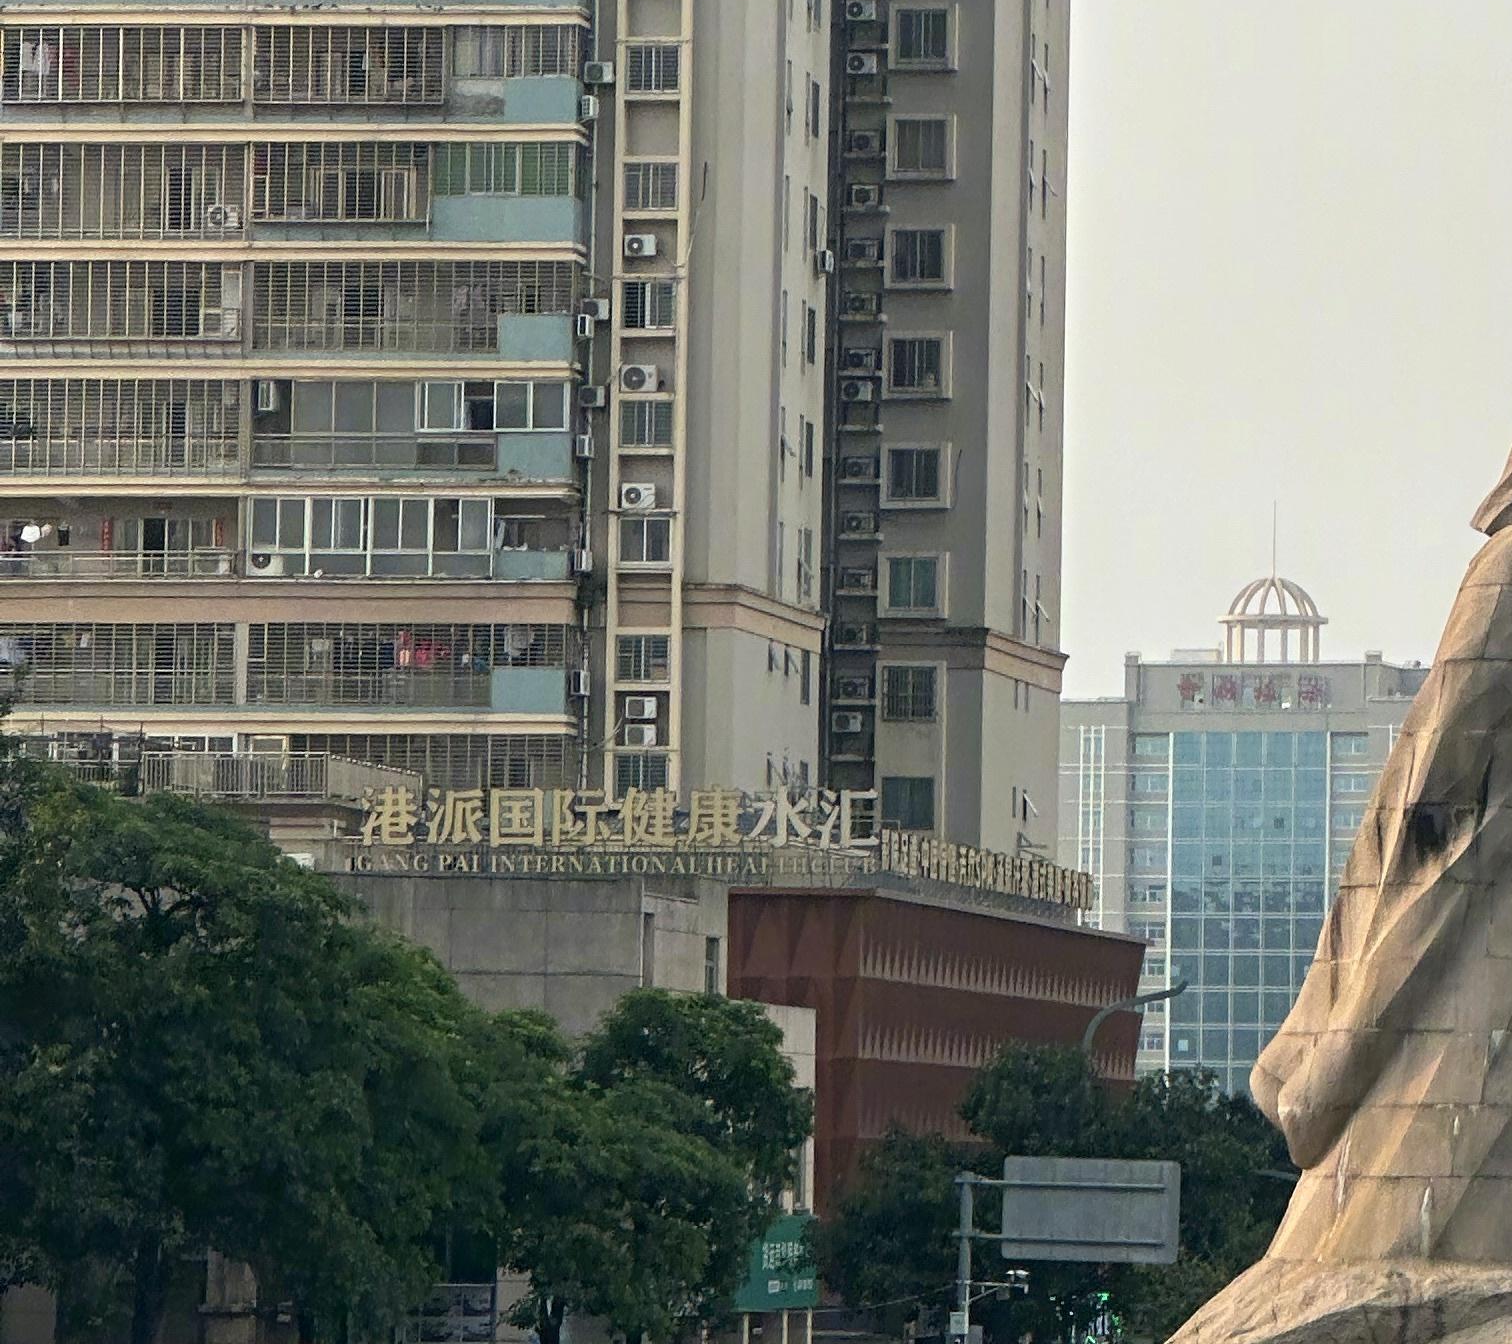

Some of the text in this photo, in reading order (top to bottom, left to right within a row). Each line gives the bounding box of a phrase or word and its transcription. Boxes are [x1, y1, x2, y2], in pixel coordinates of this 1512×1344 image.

[361, 785, 879, 848] 港派国际健康水汇
[439, 854, 480, 873] PAI
[491, 854, 701, 874] INTERNATIONAL
